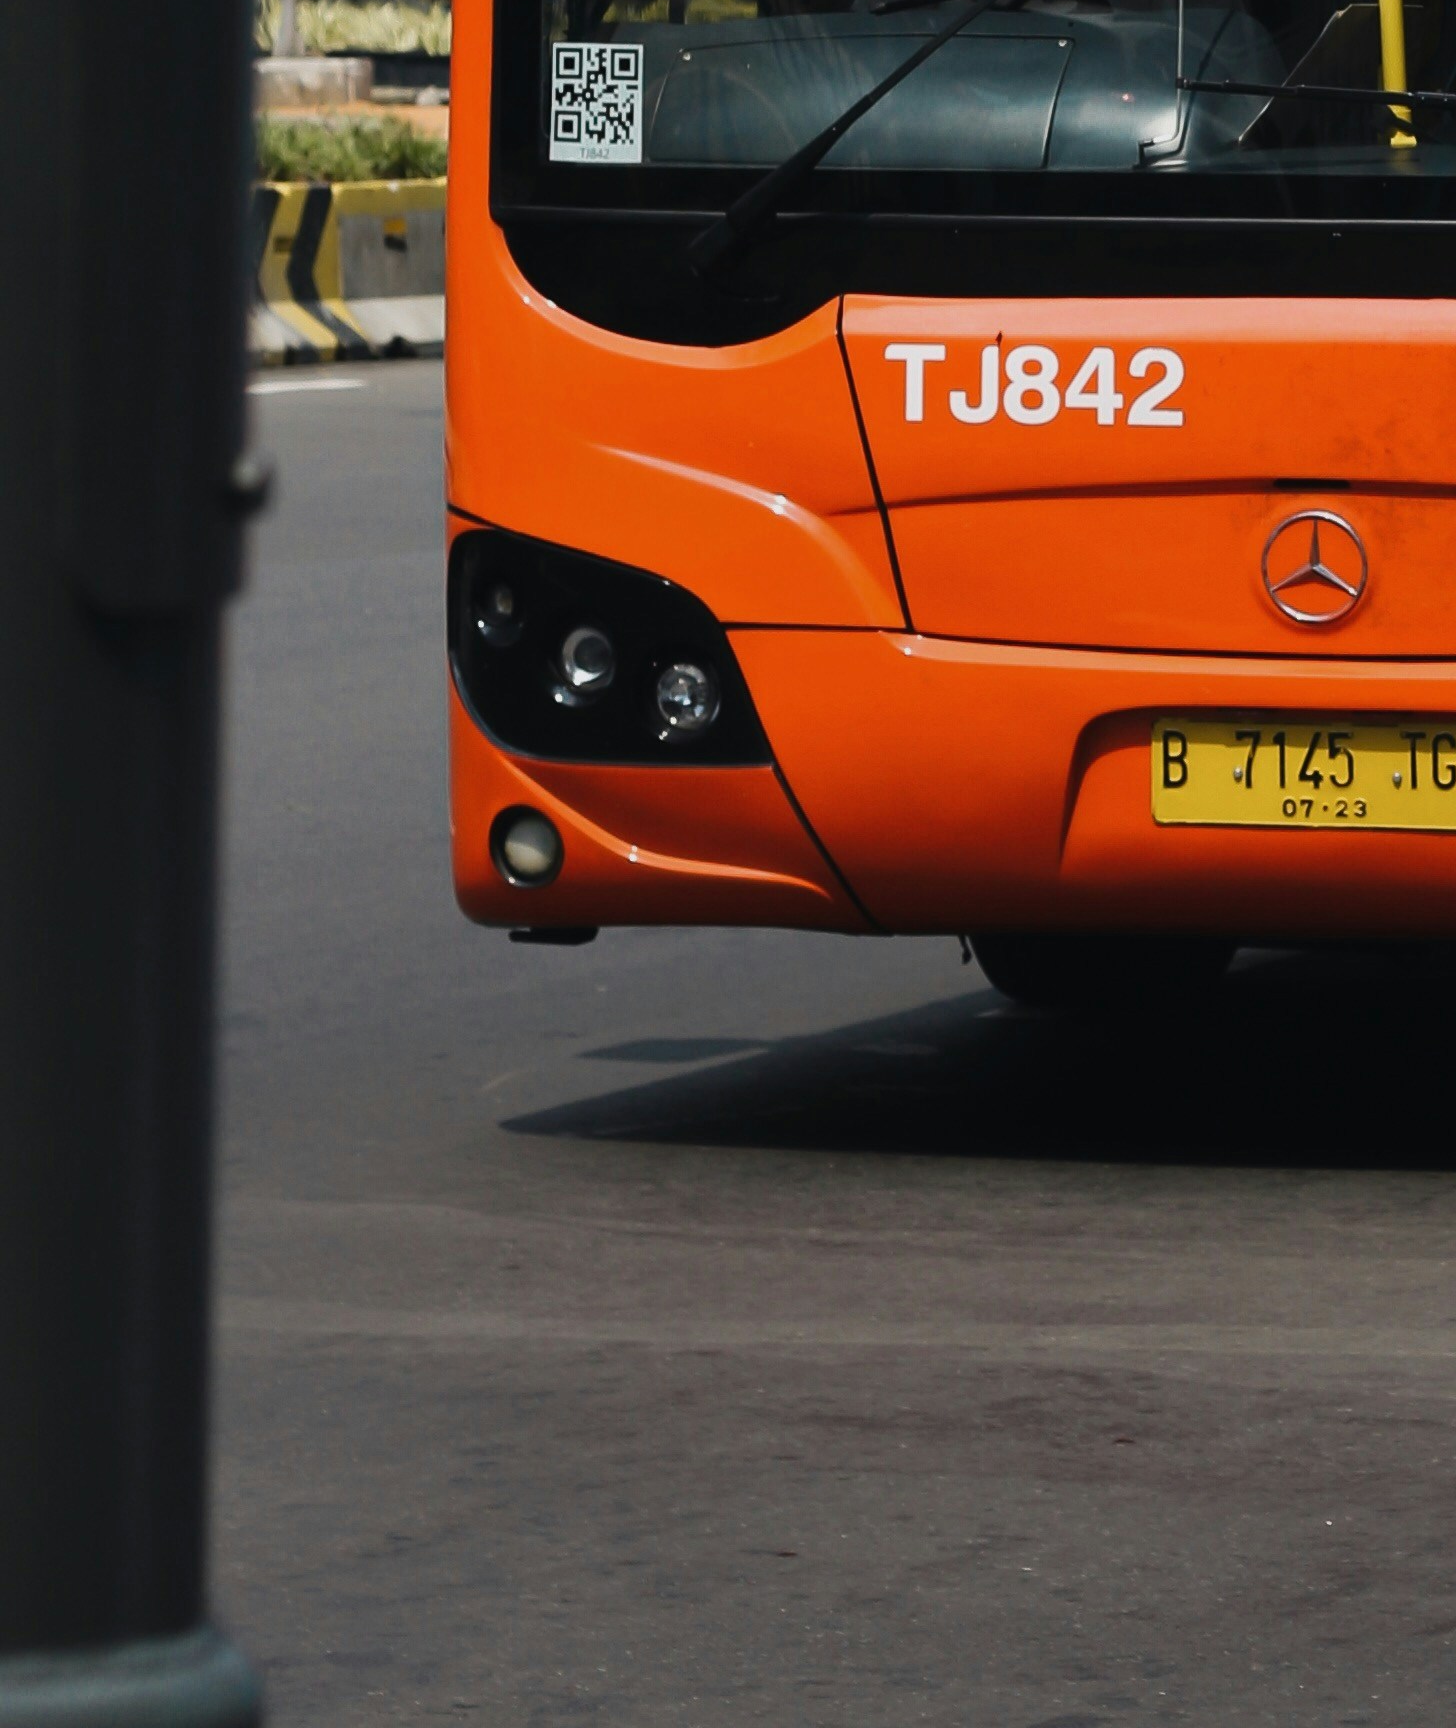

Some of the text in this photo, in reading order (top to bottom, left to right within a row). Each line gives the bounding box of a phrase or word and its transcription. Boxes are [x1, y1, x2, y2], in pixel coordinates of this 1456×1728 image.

[580, 147, 609, 160] TJ842
[884, 342, 1185, 428] TJ842
[1162, 730, 1189, 790] B
[1234, 730, 1355, 790] 7145
